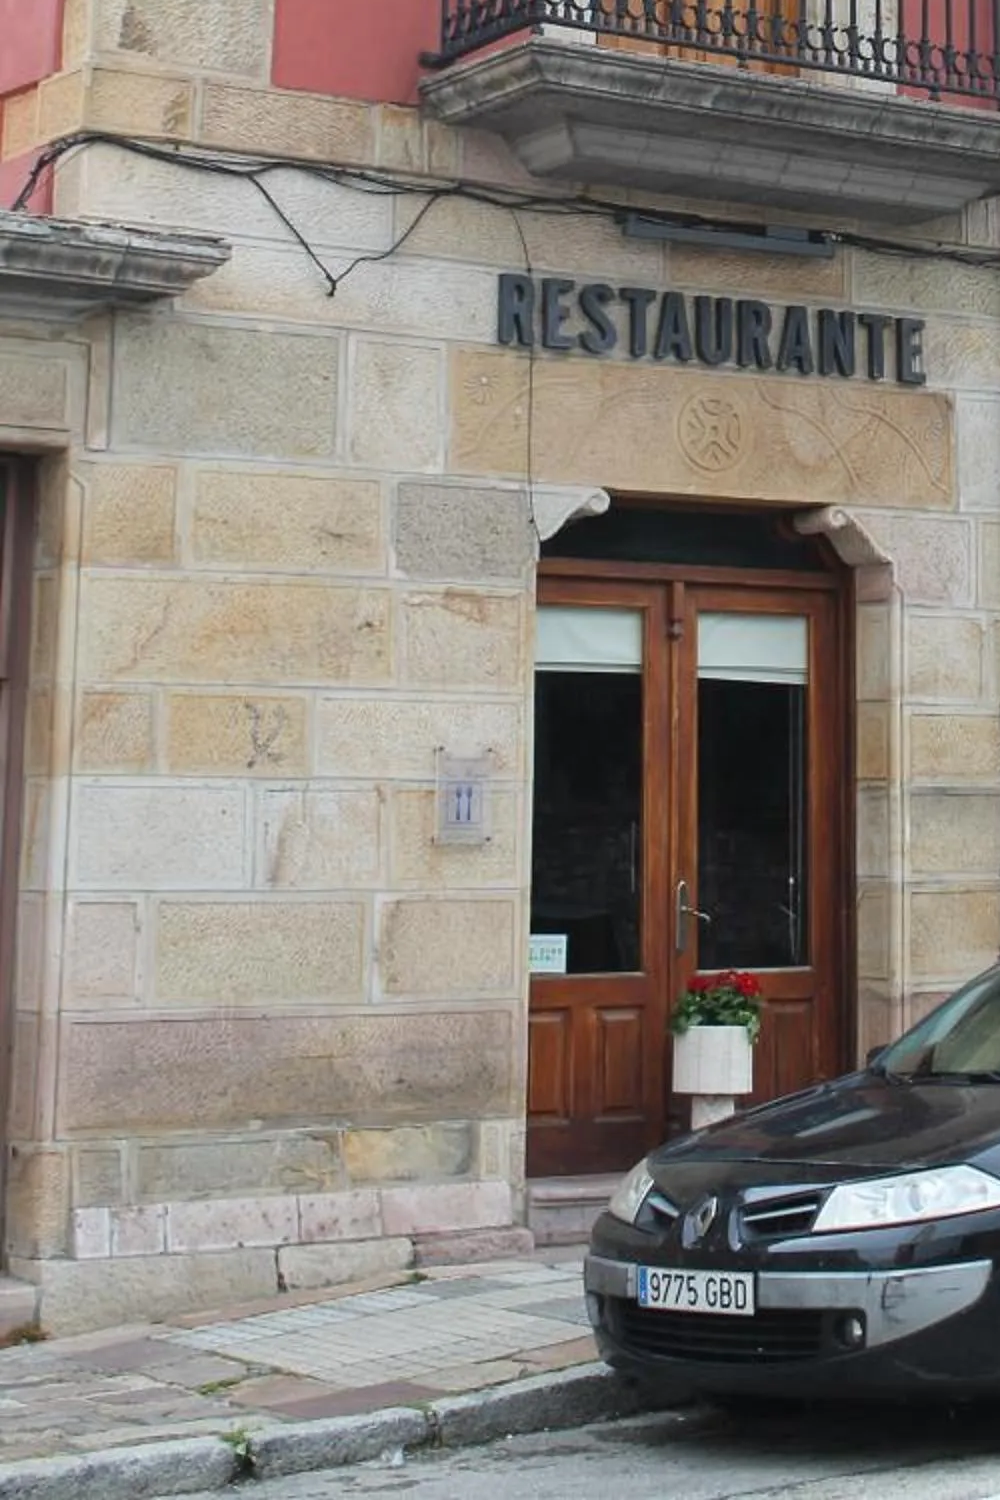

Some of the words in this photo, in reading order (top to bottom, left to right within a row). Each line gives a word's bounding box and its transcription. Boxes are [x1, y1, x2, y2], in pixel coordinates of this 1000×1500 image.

[497, 273, 926, 385] RESTAURANTE
[650, 1272, 699, 1306] 9775
[705, 1277, 747, 1310] GBD
